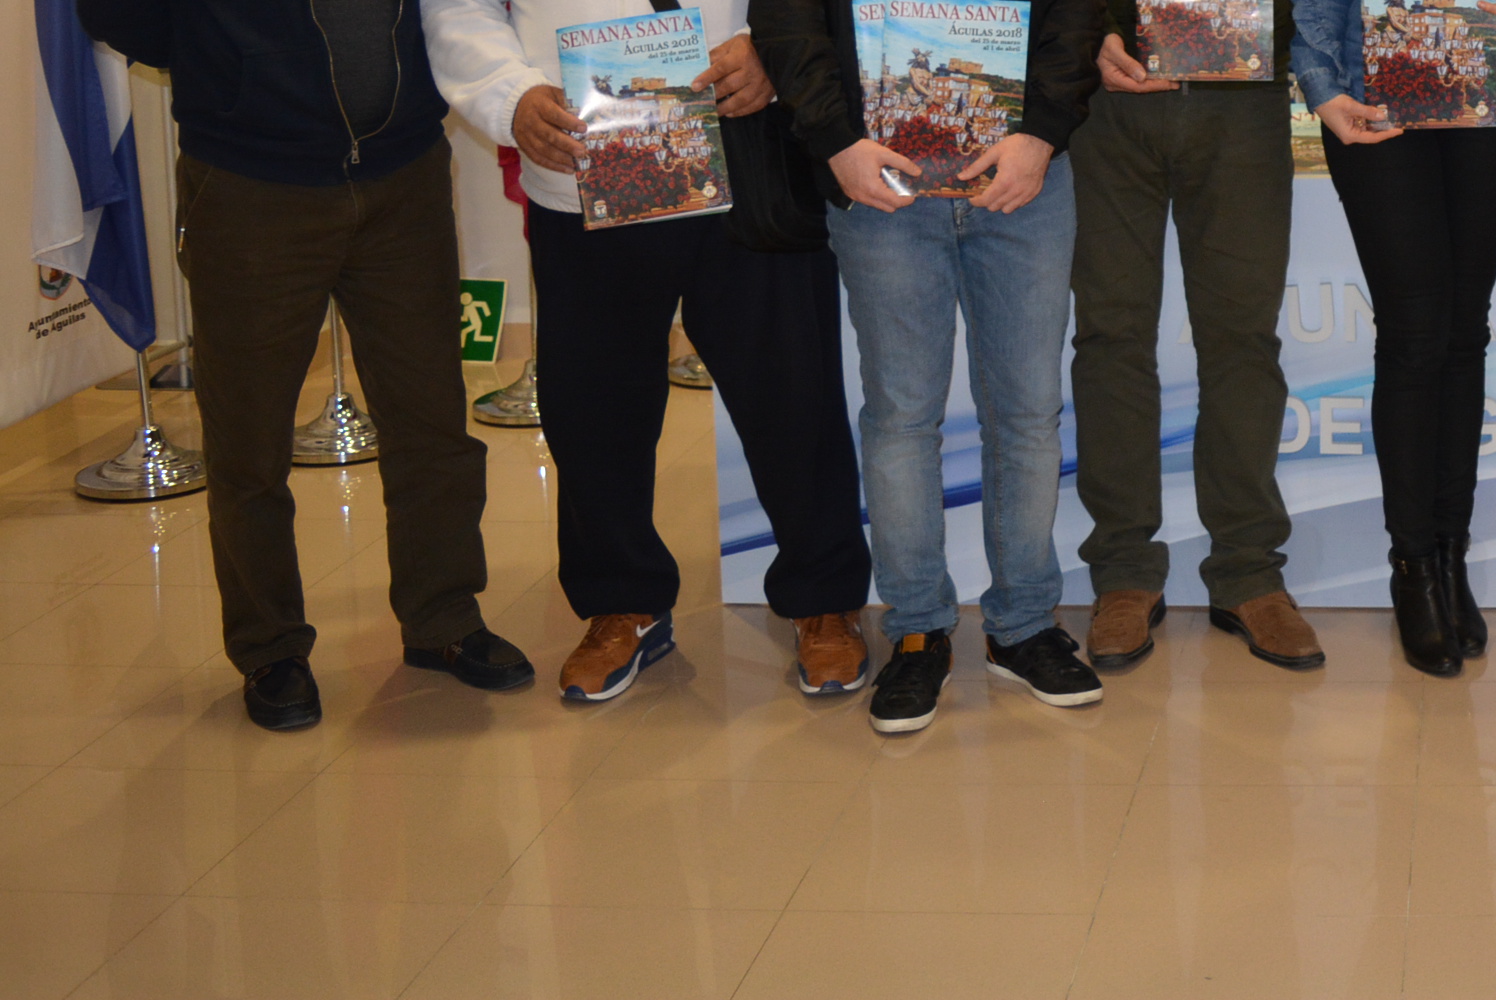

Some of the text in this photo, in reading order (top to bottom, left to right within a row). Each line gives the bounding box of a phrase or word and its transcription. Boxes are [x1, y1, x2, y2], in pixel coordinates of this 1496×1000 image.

[890, 0, 961, 20] SEMANA
[964, 4, 1021, 23] SANTA
[561, 15, 695, 50] SEMANA SANTA
[949, 21, 1022, 38] ÁGUILAS 2018
[624, 34, 699, 55] ÁGUILAS 2018
